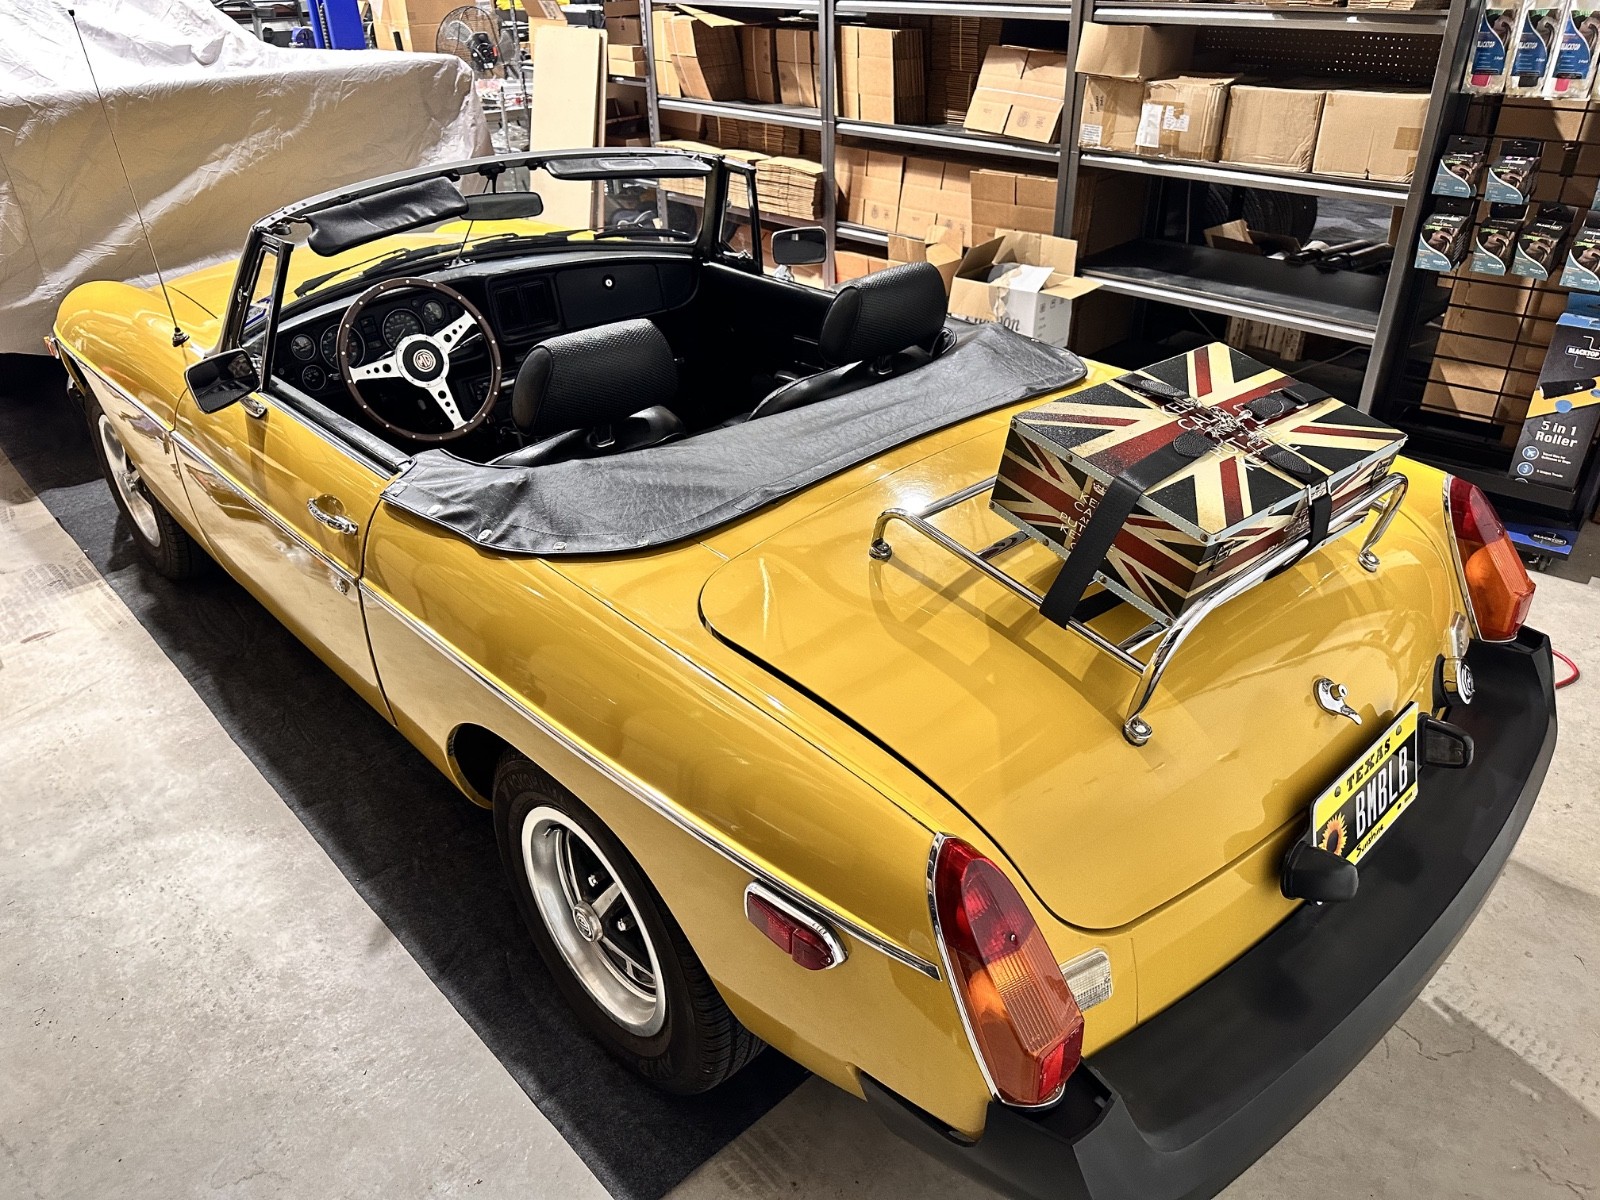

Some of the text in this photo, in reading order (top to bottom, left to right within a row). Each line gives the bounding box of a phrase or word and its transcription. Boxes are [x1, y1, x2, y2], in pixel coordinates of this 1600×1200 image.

[1535, 430, 1578, 448] Roller
[1541, 420, 1577, 436] 5 in 1
[1346, 737, 1391, 792] TEXAS
[1355, 746, 1408, 840] BMBLB
